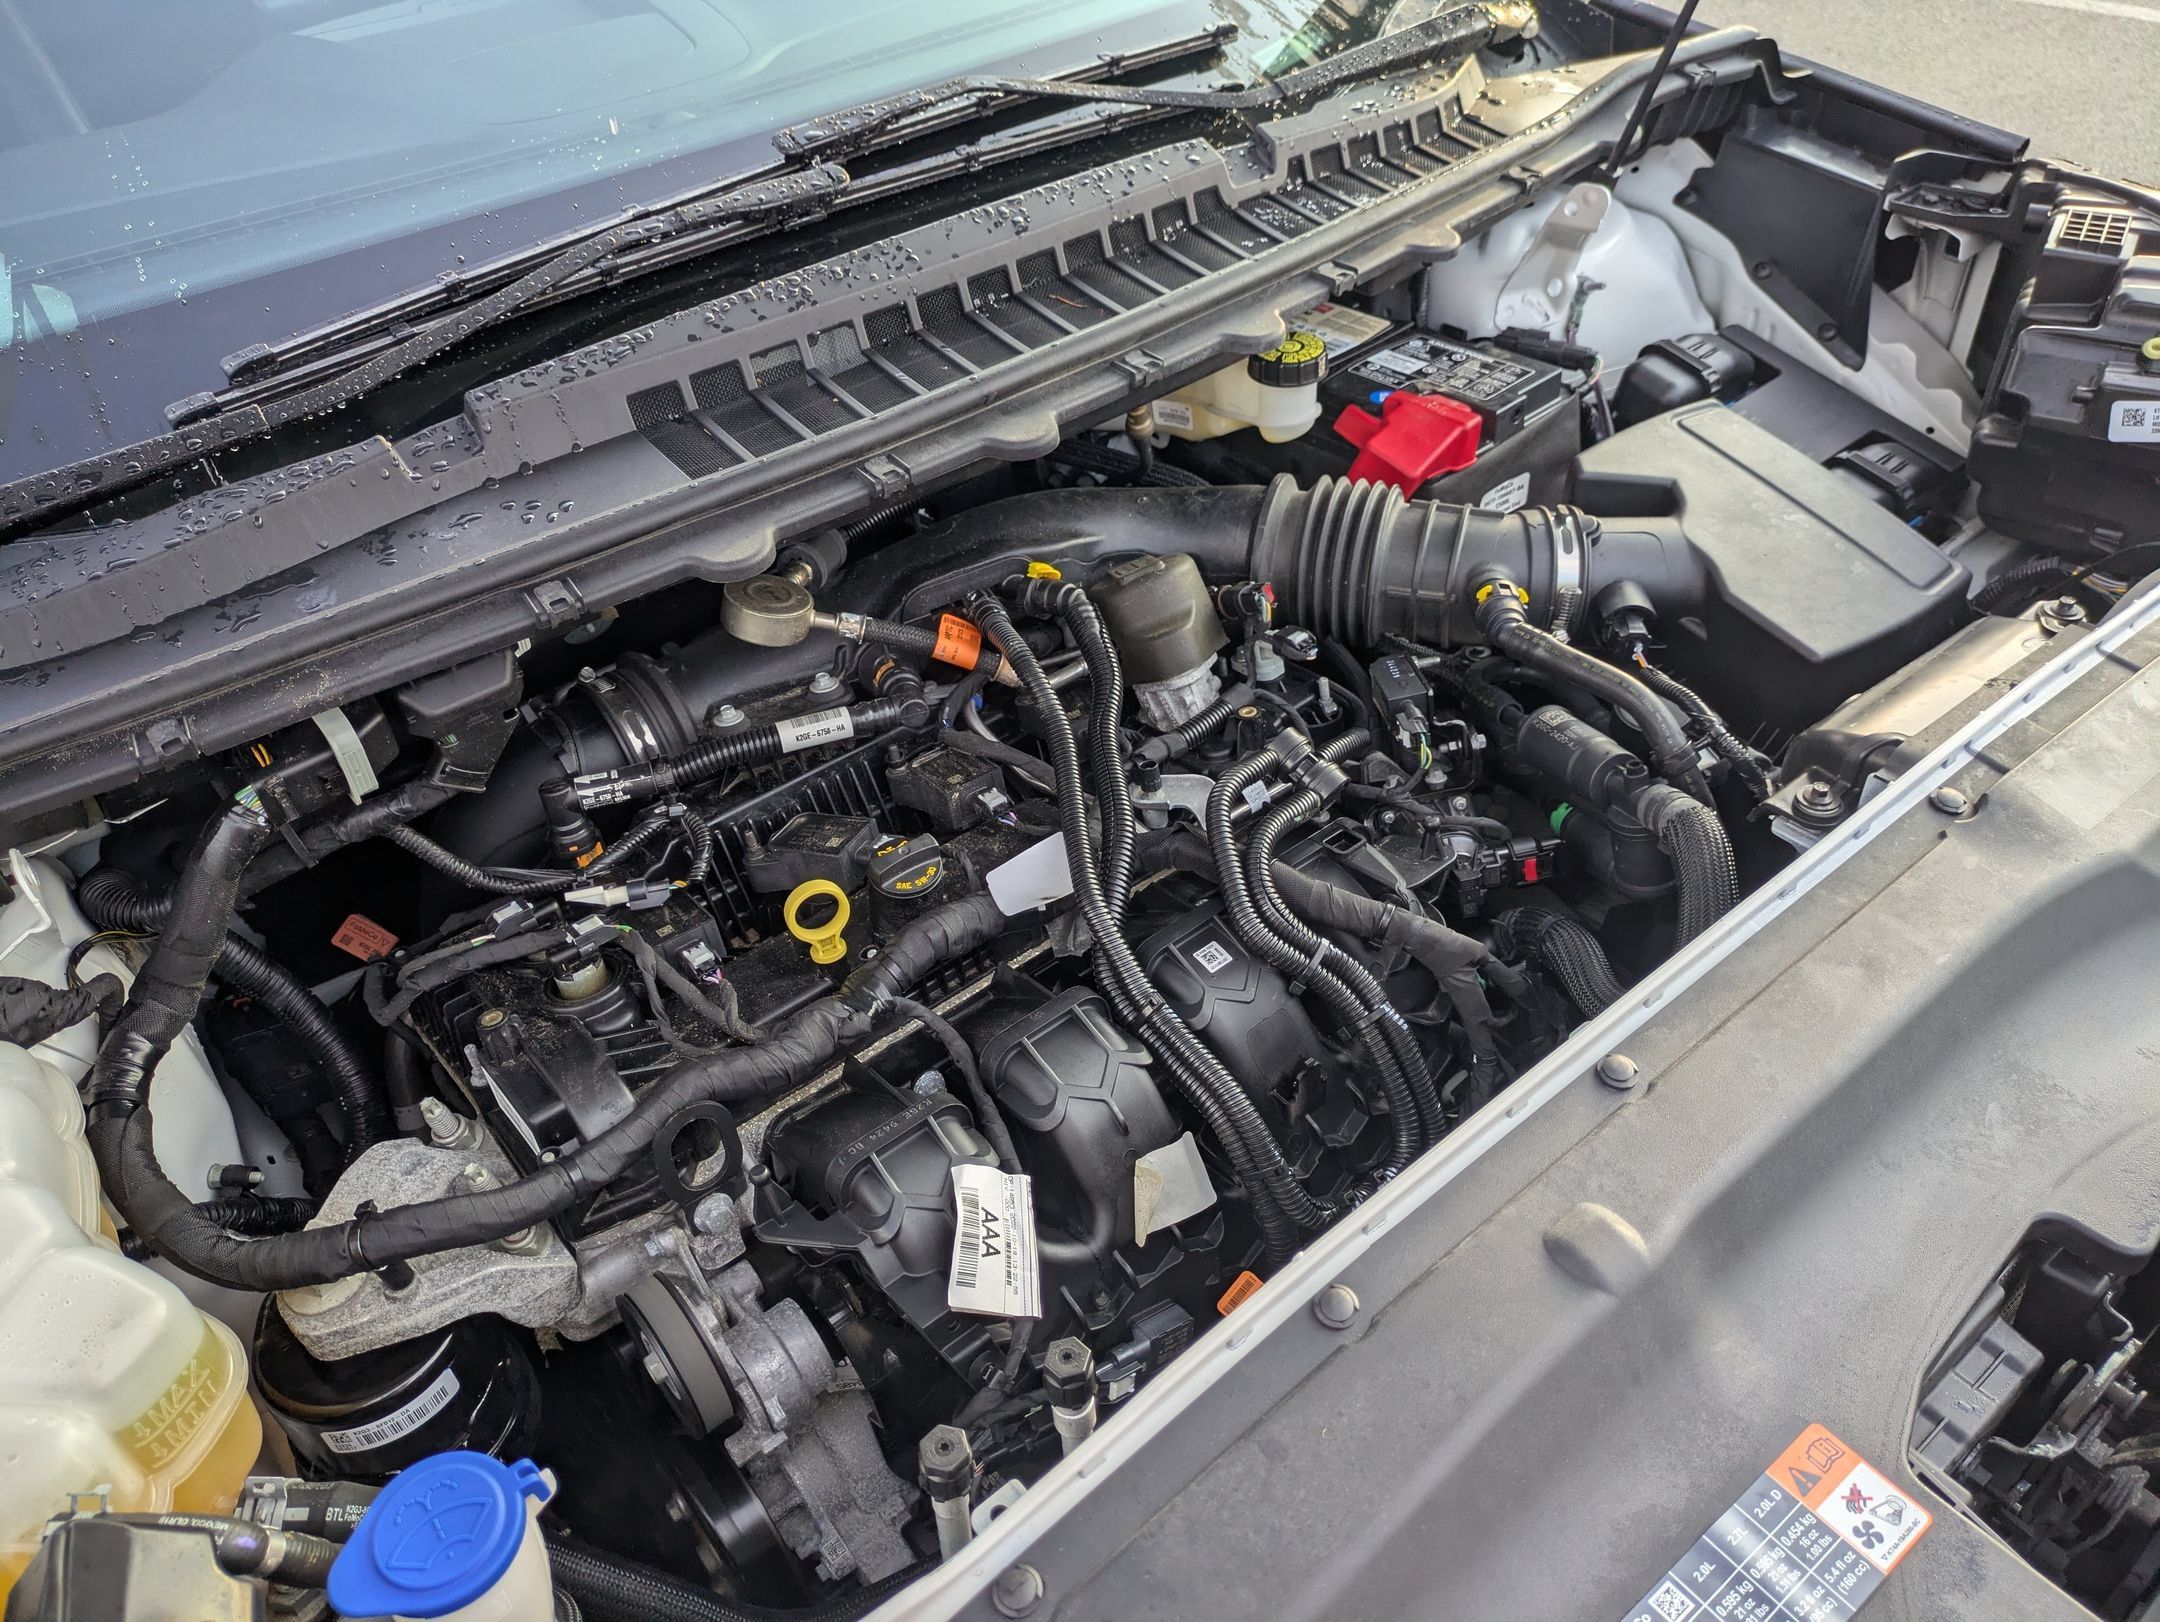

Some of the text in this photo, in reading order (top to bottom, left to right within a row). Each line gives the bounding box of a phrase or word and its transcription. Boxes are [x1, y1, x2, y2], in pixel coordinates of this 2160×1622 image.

[895, 866, 937, 890] SAE 5W-30
[981, 1206, 1001, 1258] AAA
[325, 1507, 344, 1522] BTL
[1754, 1489, 1783, 1519] 2.0L D
[1780, 1512, 1817, 1547] 0.454 kg
[1799, 1528, 1820, 1549] 16 oz
[1771, 1546, 1786, 1561] kg
[1806, 1534, 1833, 1561] 1.00 lbs
[1692, 1561, 1716, 1584] 2.0L
[1767, 1562, 1789, 1582] 21 oz
[1788, 1568, 1802, 1583] lbs
[1824, 1550, 1857, 1584] 5.4 fl oz
[1837, 1559, 1871, 1596] (160 cc)
[1715, 1580, 1754, 1618] 0.595 kg
[1814, 1584, 1826, 1598] oz
[1733, 1597, 1757, 1620] 21 oz
[1753, 1603, 1770, 1618] lbs
[1822, 1596, 1838, 1614] cc)
